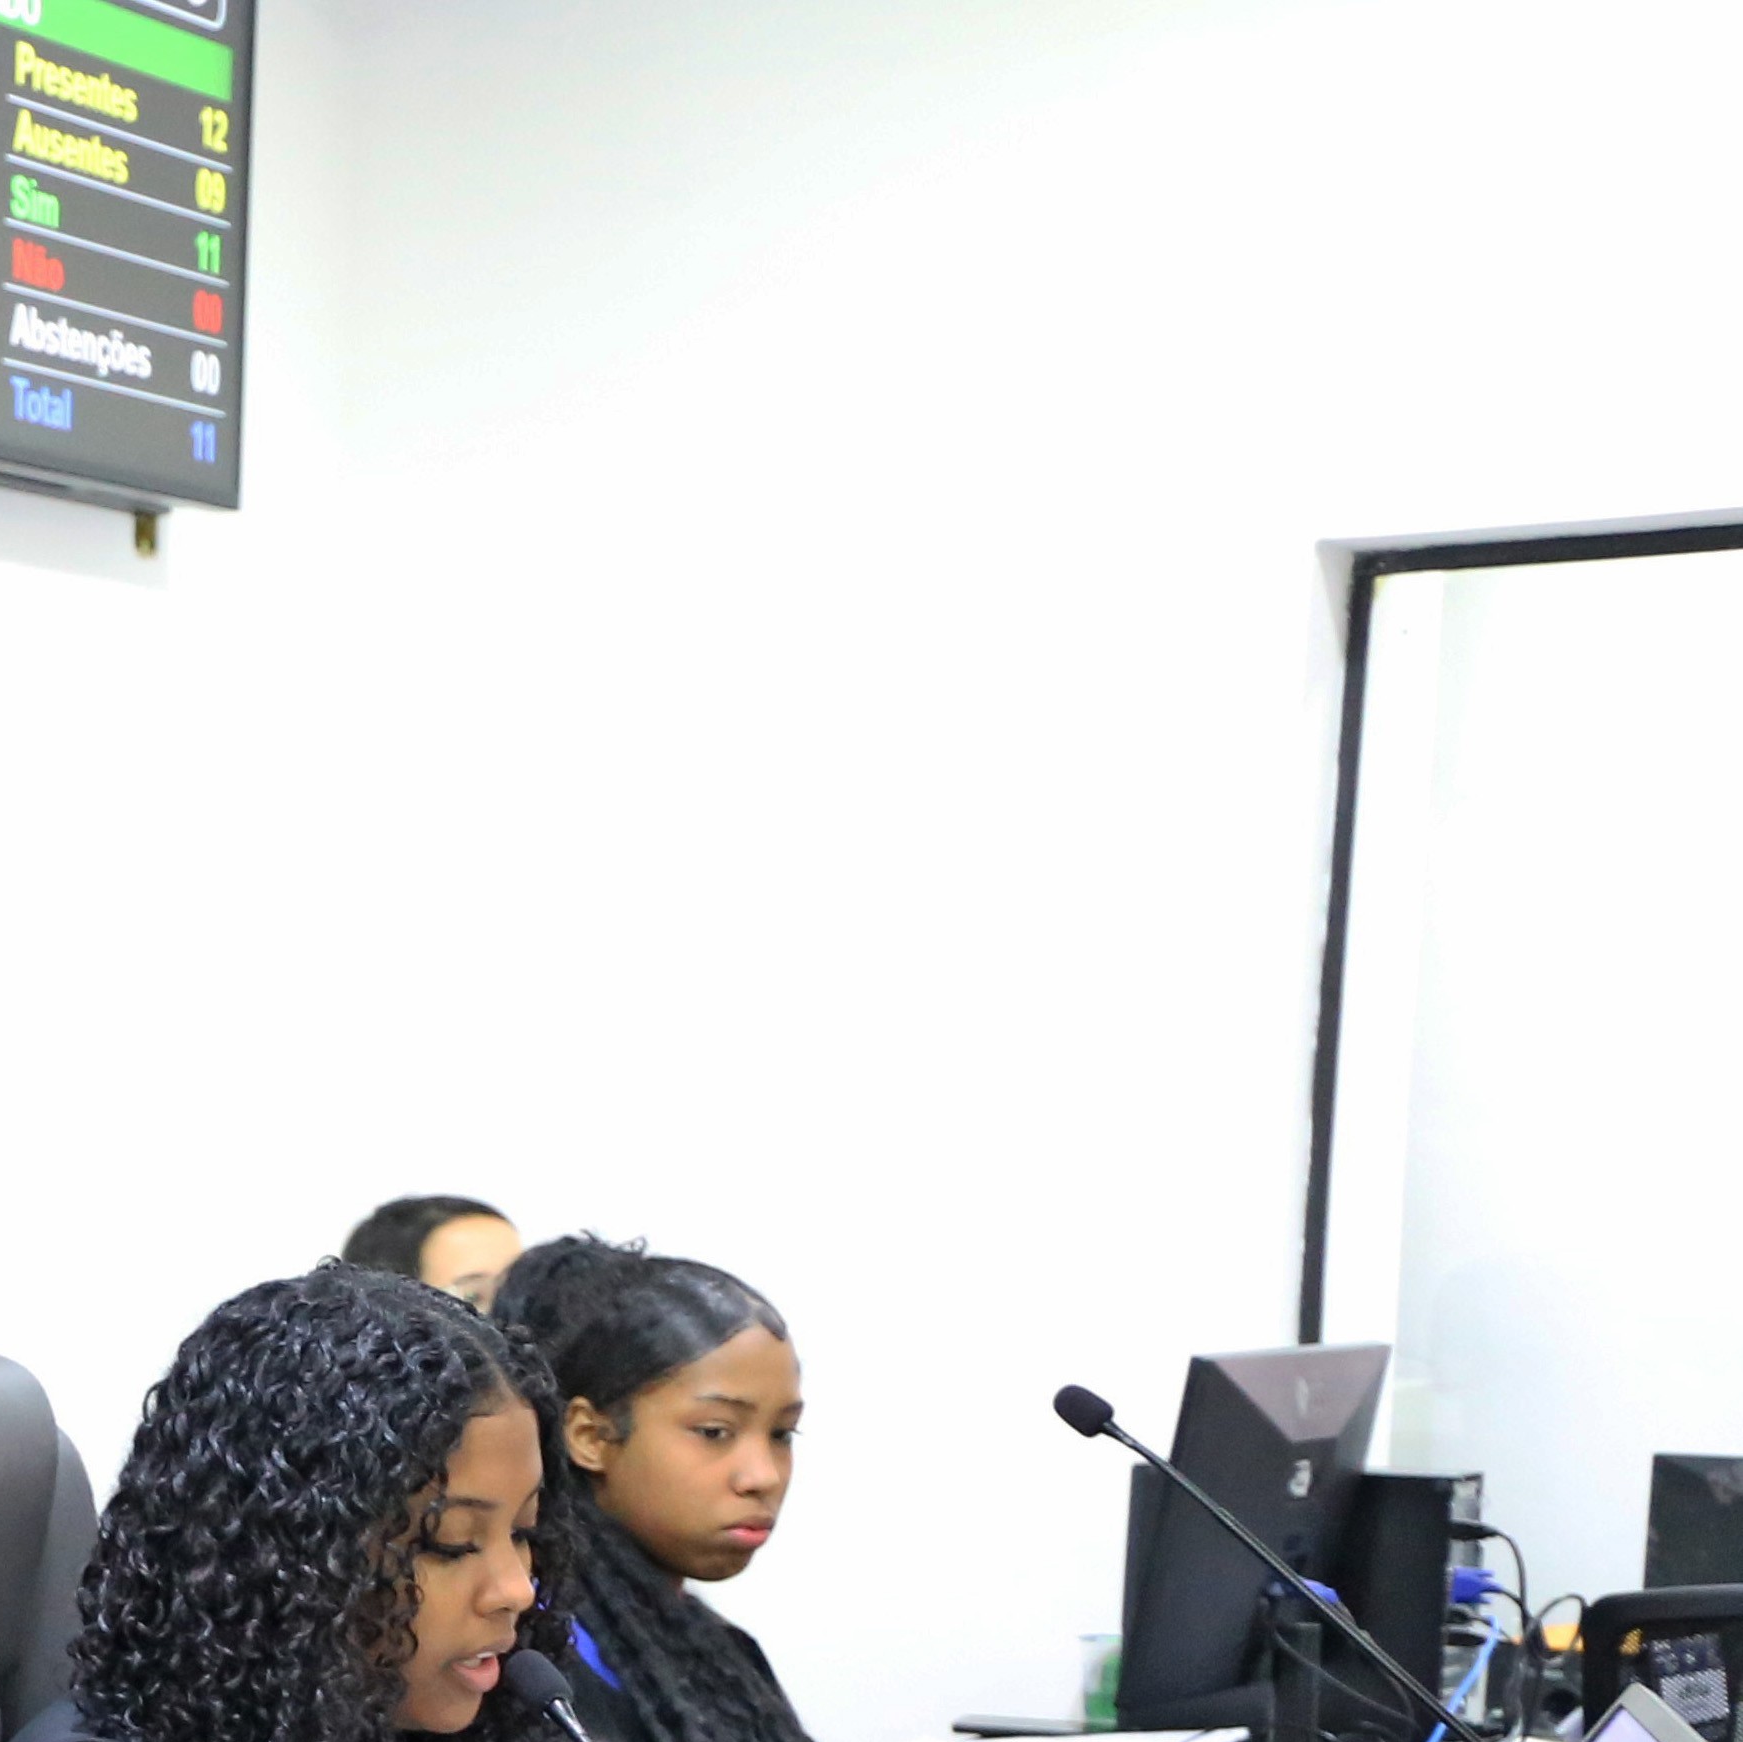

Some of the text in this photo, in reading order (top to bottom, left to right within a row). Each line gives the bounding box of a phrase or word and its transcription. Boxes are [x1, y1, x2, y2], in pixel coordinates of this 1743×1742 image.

[14, 40, 229, 153] Presentes 12
[12, 108, 129, 185] Ausentes
[9, 173, 221, 276] Sim 11
[9, 302, 222, 397] Abstenções 00
[9, 374, 217, 464] Total 11
